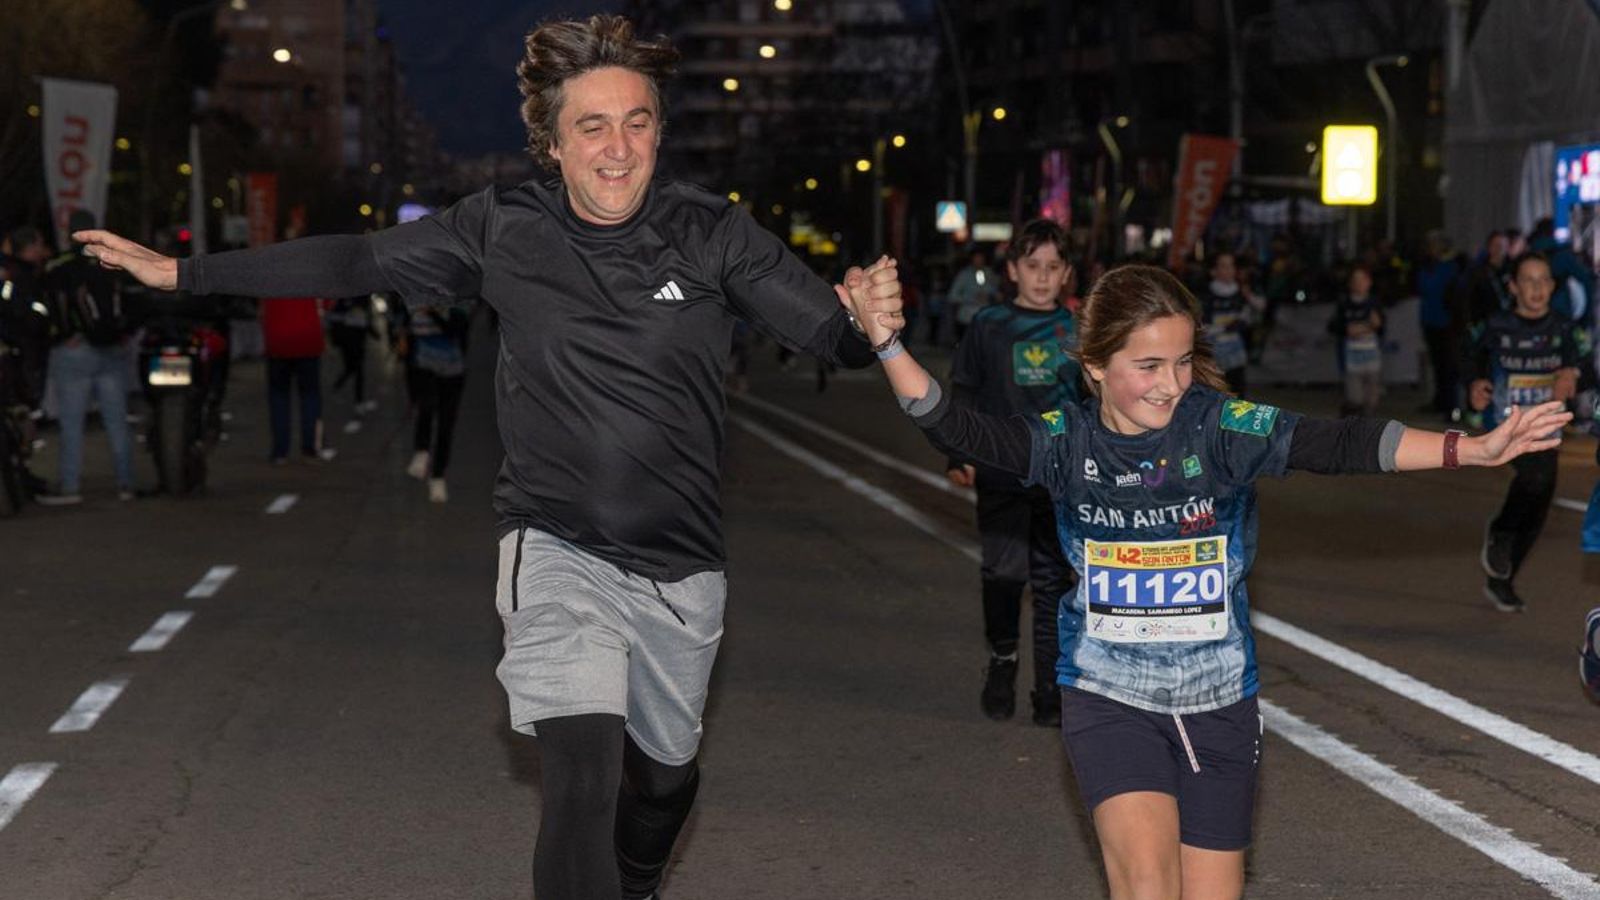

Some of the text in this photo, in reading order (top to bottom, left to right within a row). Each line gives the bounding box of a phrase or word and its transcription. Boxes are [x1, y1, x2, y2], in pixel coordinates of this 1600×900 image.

[1078, 496, 1214, 528] SAN ANTÓN
[1117, 547, 1141, 564] 42
[1091, 568, 1223, 604] 11120
